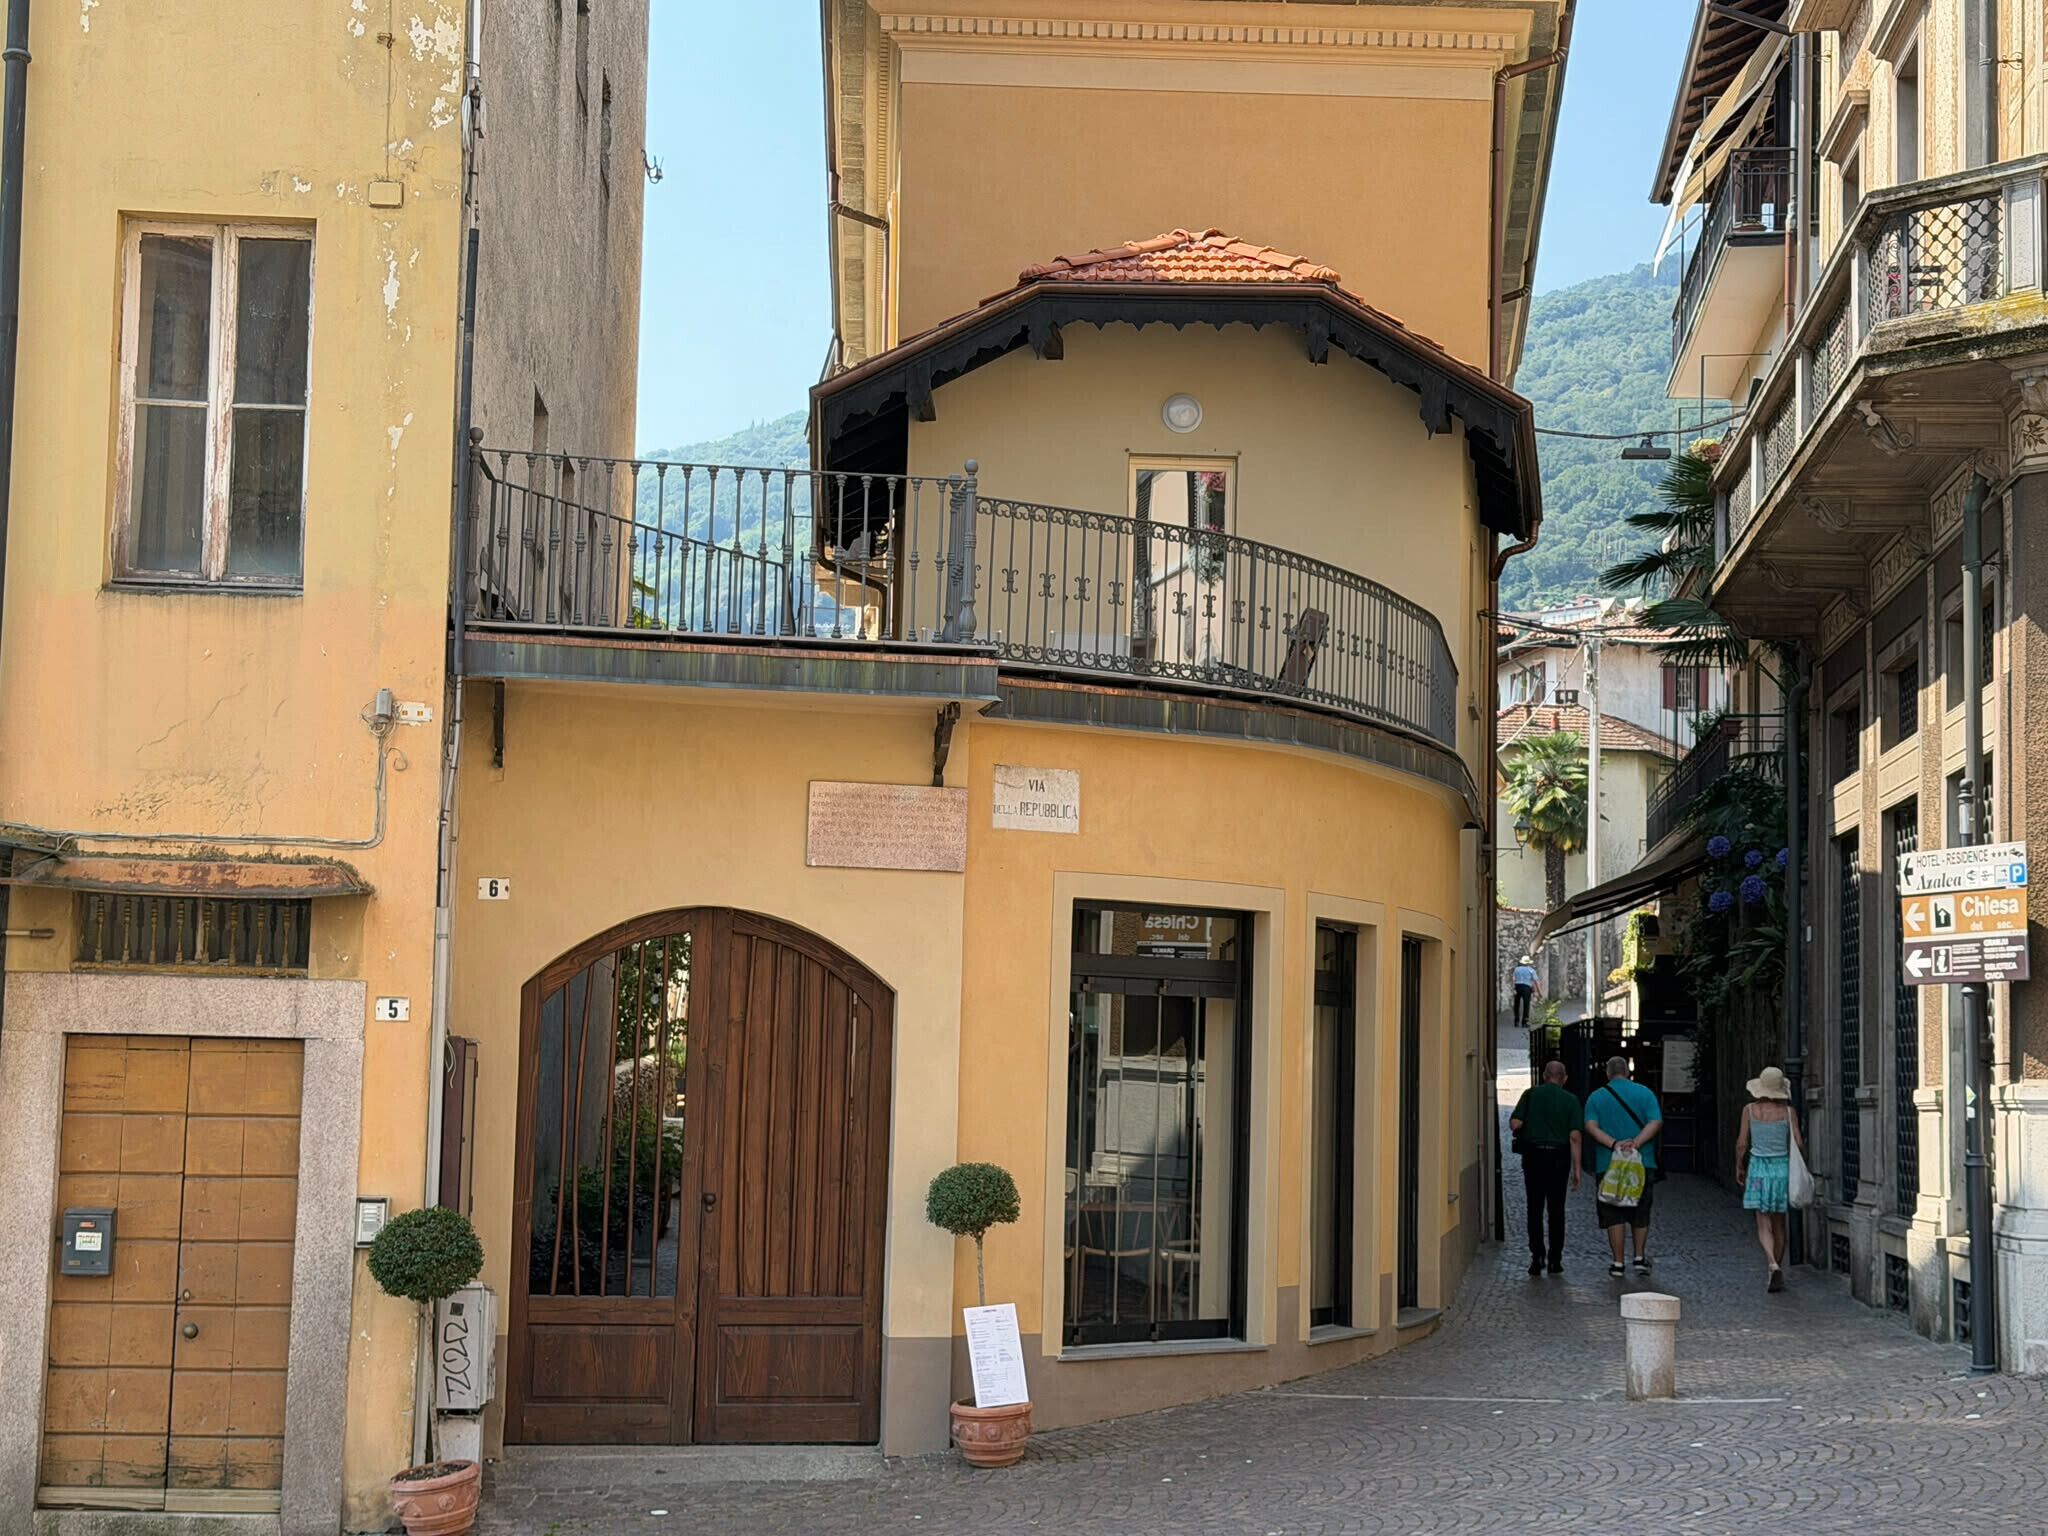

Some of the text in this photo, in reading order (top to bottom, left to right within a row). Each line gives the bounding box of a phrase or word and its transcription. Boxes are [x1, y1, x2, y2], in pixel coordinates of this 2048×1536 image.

[1028, 779, 1046, 793] VIA
[993, 801, 1078, 820] DELLA REPUBBLICA
[1917, 854, 1940, 868] HOTEL
[1947, 849, 1989, 865] RESIDENCE
[488, 879, 499, 897] 6
[1916, 873, 1962, 890] Azalea
[1961, 895, 2019, 918] Chiesa
[387, 999, 399, 1018] 5
